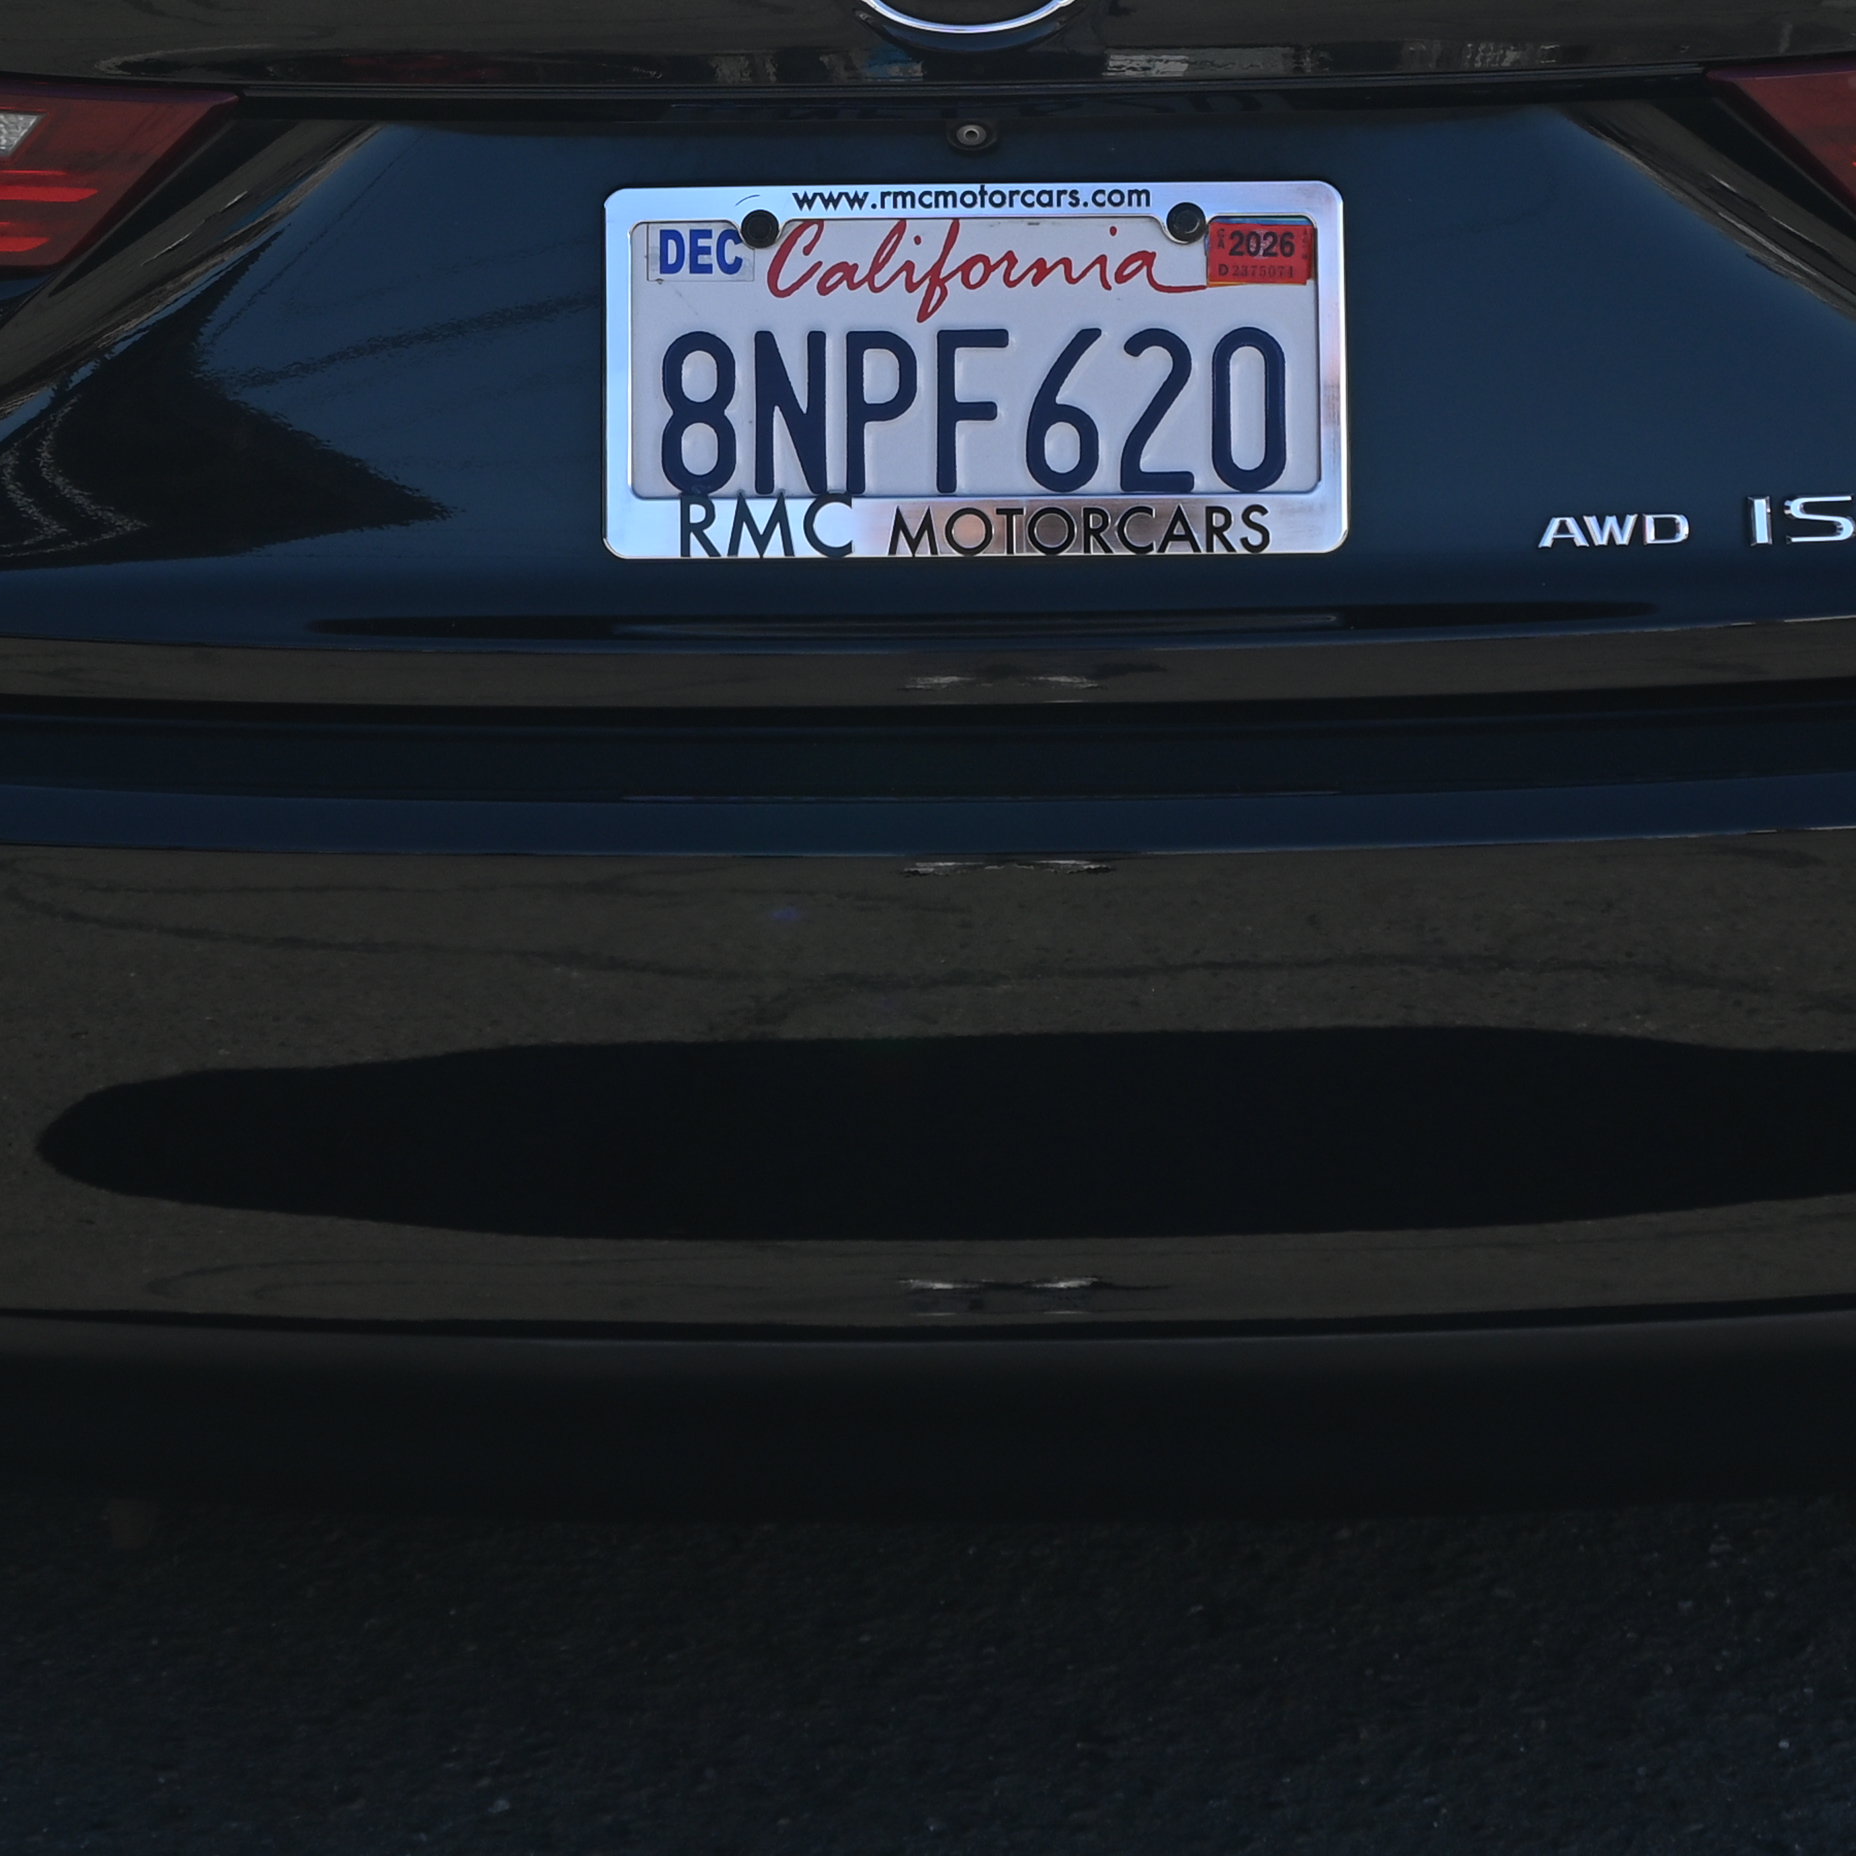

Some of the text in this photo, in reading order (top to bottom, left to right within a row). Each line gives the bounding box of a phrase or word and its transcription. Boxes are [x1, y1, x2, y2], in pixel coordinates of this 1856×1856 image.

[791, 184, 1152, 211] www.rmcmotorcars.com
[659, 229, 744, 275] DEC
[1229, 229, 1296, 258] 2026
[766, 219, 1208, 324] California
[661, 326, 1287, 495] 8NPF620
[678, 492, 1271, 558] RMC MOTORCARS
[1538, 513, 1691, 549] AWD
[1747, 494, 1856, 546] IS
